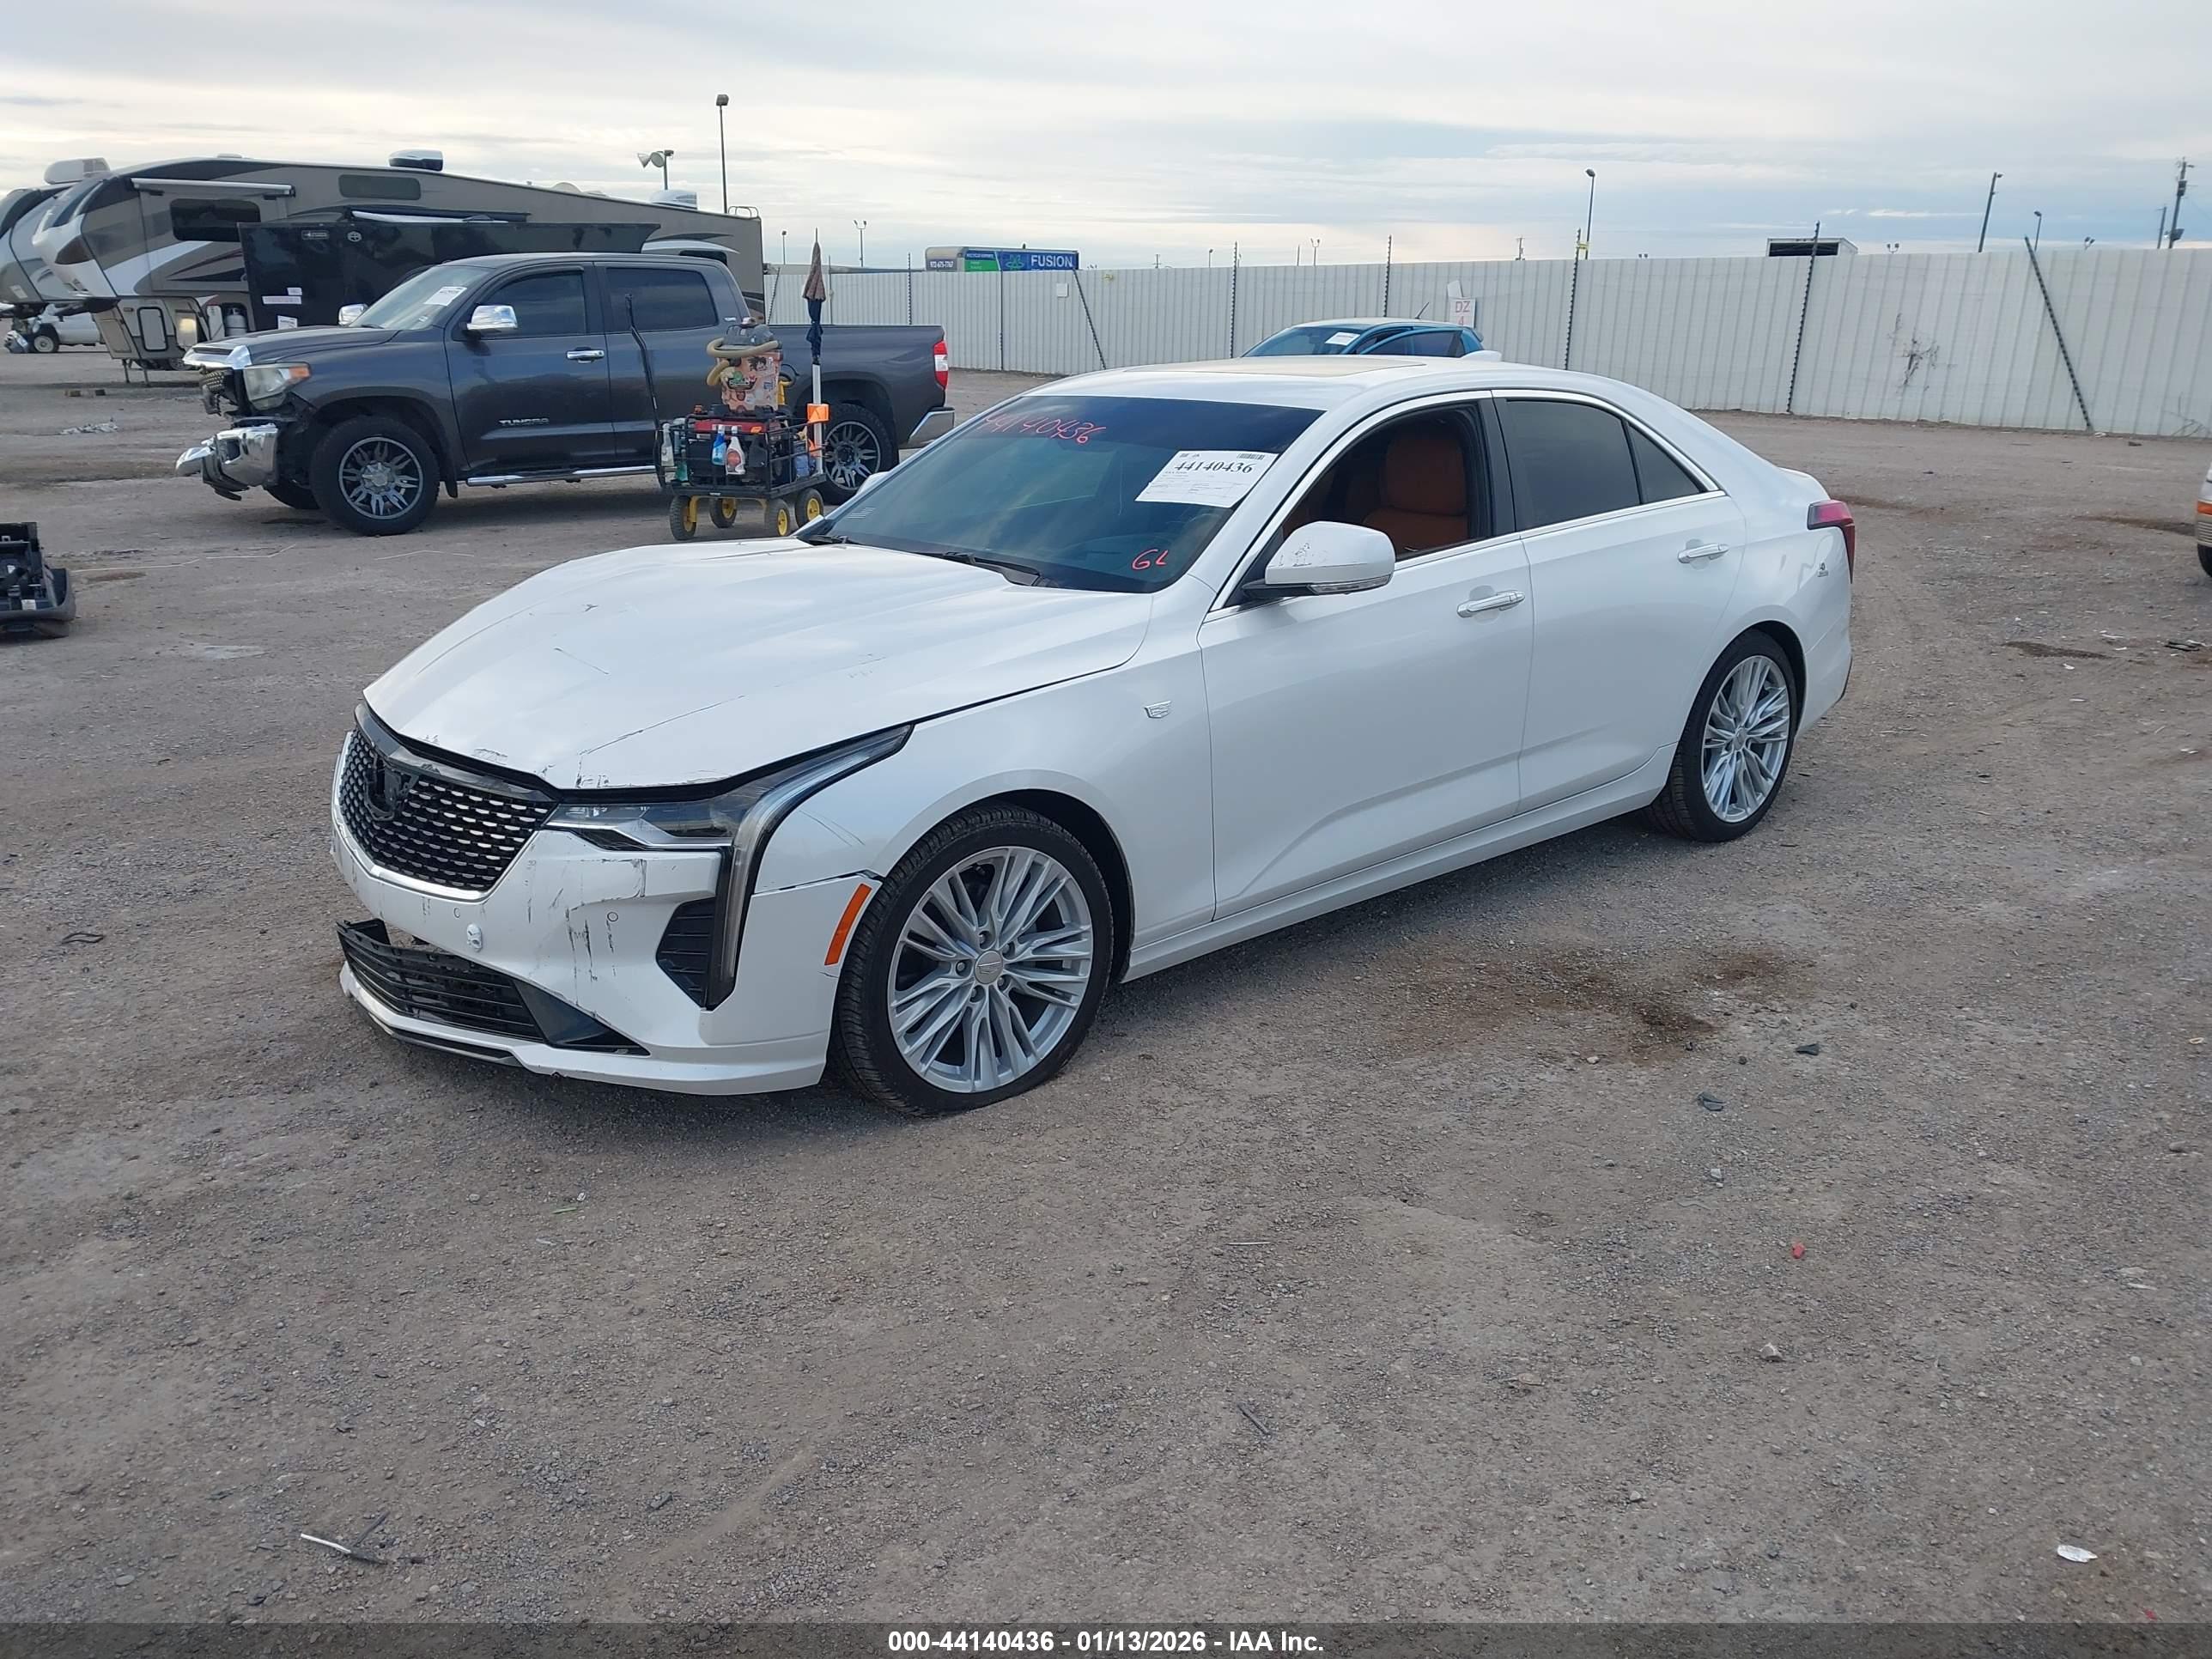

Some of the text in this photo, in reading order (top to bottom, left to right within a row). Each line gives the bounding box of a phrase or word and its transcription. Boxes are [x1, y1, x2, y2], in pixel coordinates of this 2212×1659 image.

[1030, 255, 1073, 268] FUSION
[1455, 301, 1471, 313] DZ
[1175, 460, 1256, 473] 44140436
